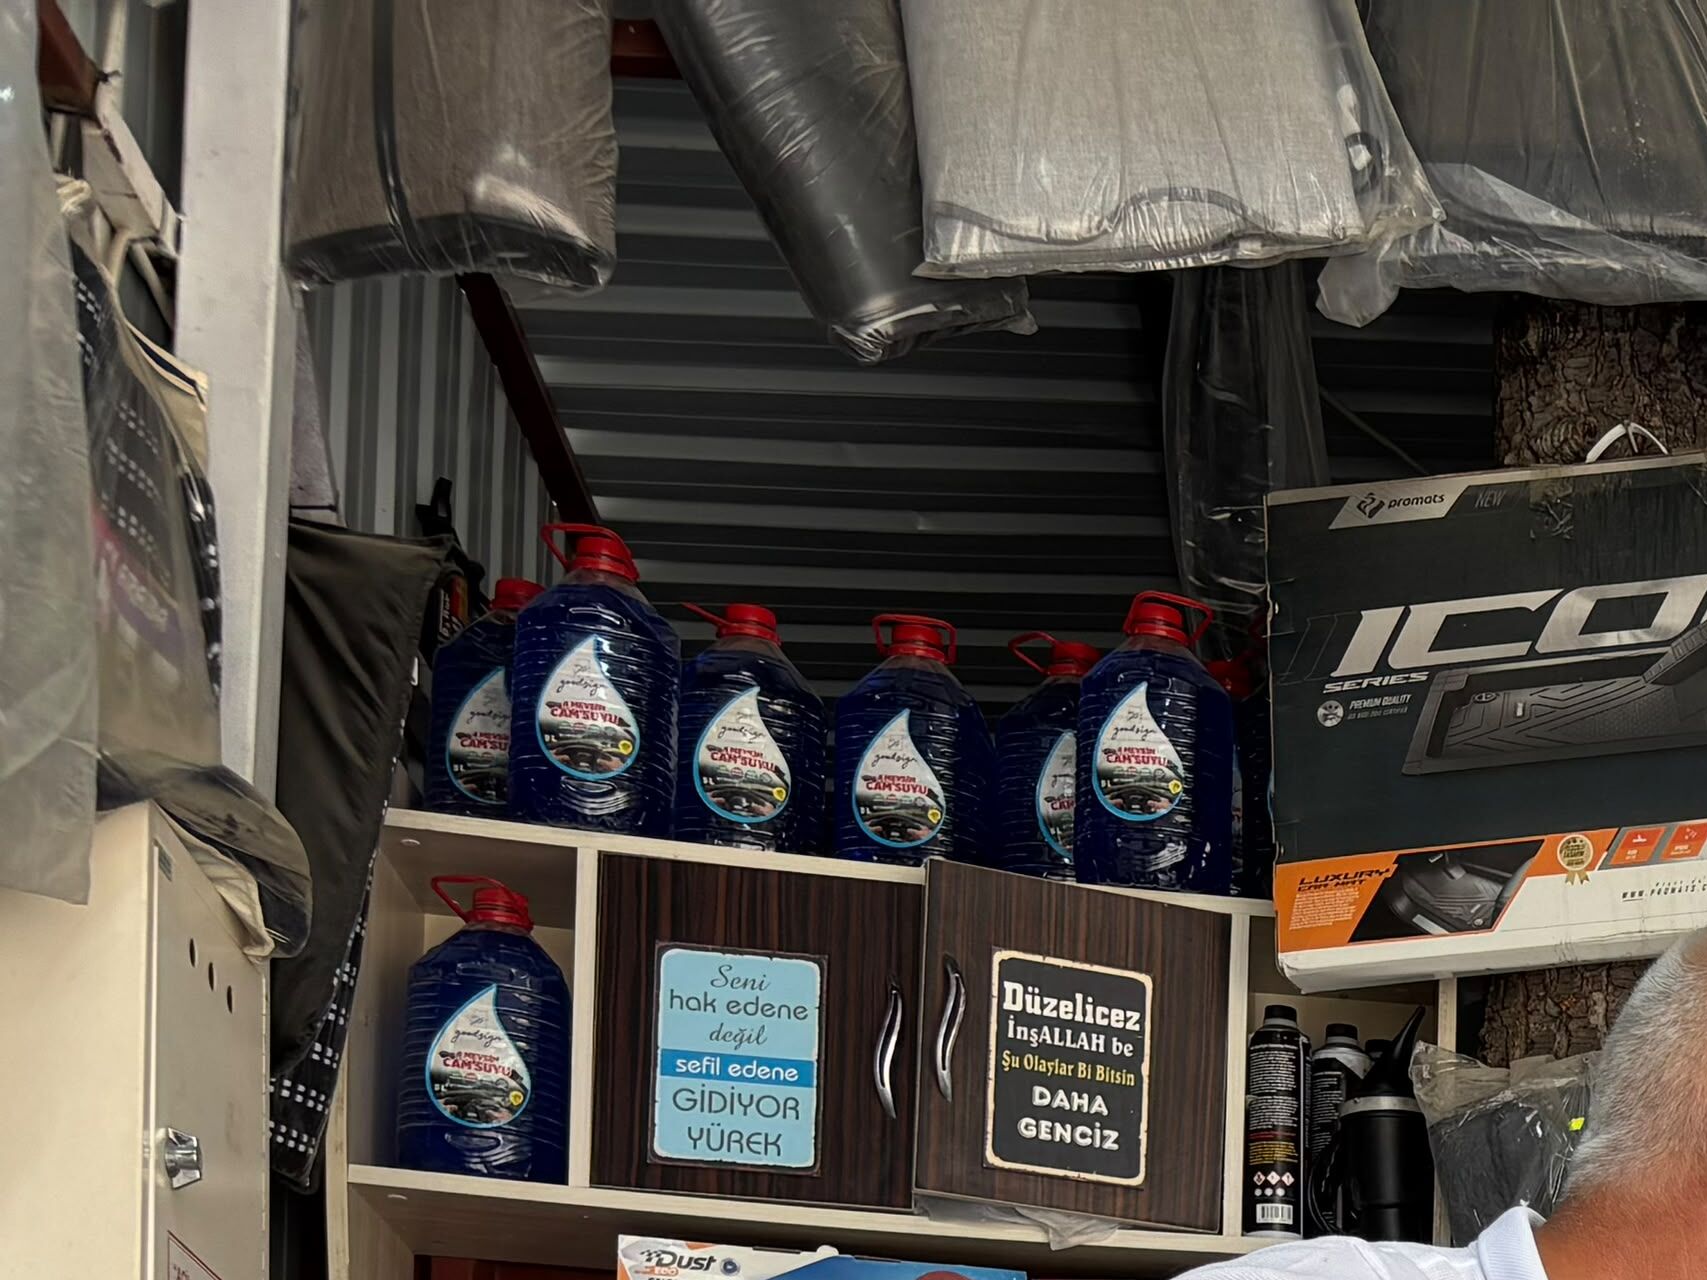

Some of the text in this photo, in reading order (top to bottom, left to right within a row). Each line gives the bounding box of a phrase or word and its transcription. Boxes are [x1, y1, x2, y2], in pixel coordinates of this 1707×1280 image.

[1388, 492, 1446, 510] promats
[1323, 671, 1430, 694] SERIES
[1299, 868, 1390, 885] LUXURY
[709, 964, 770, 992] Seni
[669, 987, 809, 1022] hak edene
[1003, 980, 1141, 1031] Düzelicez
[709, 1021, 768, 1048] değil
[1007, 1014, 1134, 1057] İnşALLAH be
[675, 1054, 798, 1083] sefil edene
[1002, 1050, 1136, 1086] Şu Olaylar Bi Bitsin
[672, 1083, 801, 1122] GİDİYOR
[1032, 1085, 1109, 1116] DAHA
[687, 1121, 783, 1157] YÜREK
[1017, 1117, 1119, 1150] GENCİZ
